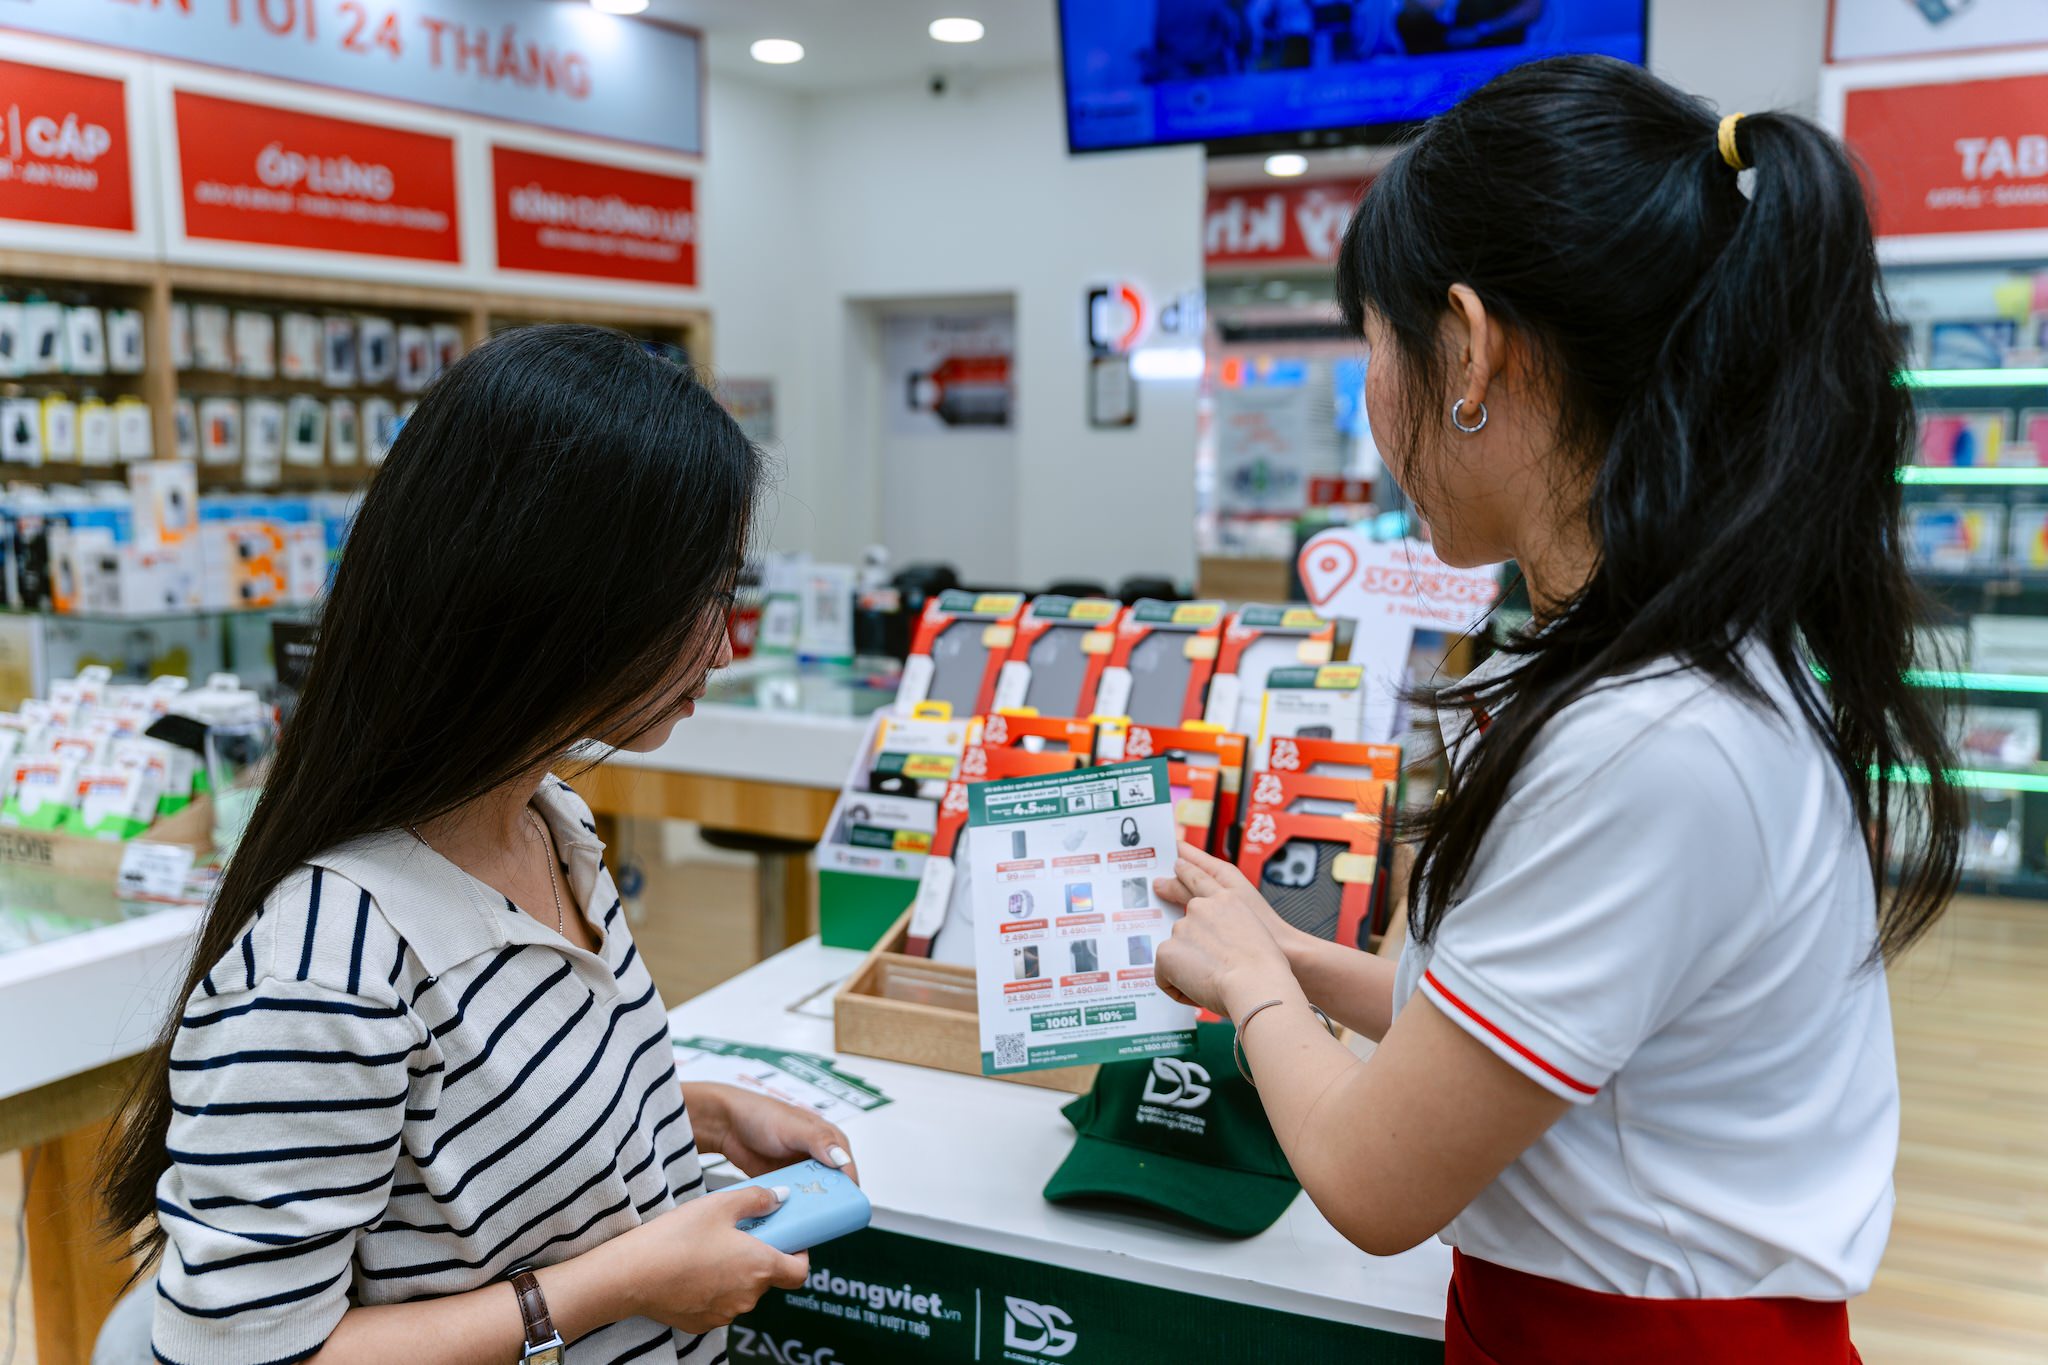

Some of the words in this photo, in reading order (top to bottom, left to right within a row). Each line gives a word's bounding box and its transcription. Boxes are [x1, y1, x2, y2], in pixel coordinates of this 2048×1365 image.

[340, 1, 403, 60] 24
[420, 16, 593, 101] THÁNG
[25, 111, 112, 164] CÁP
[1045, 1014, 1079, 1030] 100K
[1097, 1009, 1122, 1024] 10%
[822, 1301, 843, 1317] GIAO
[845, 1305, 861, 1320] GIÁ
